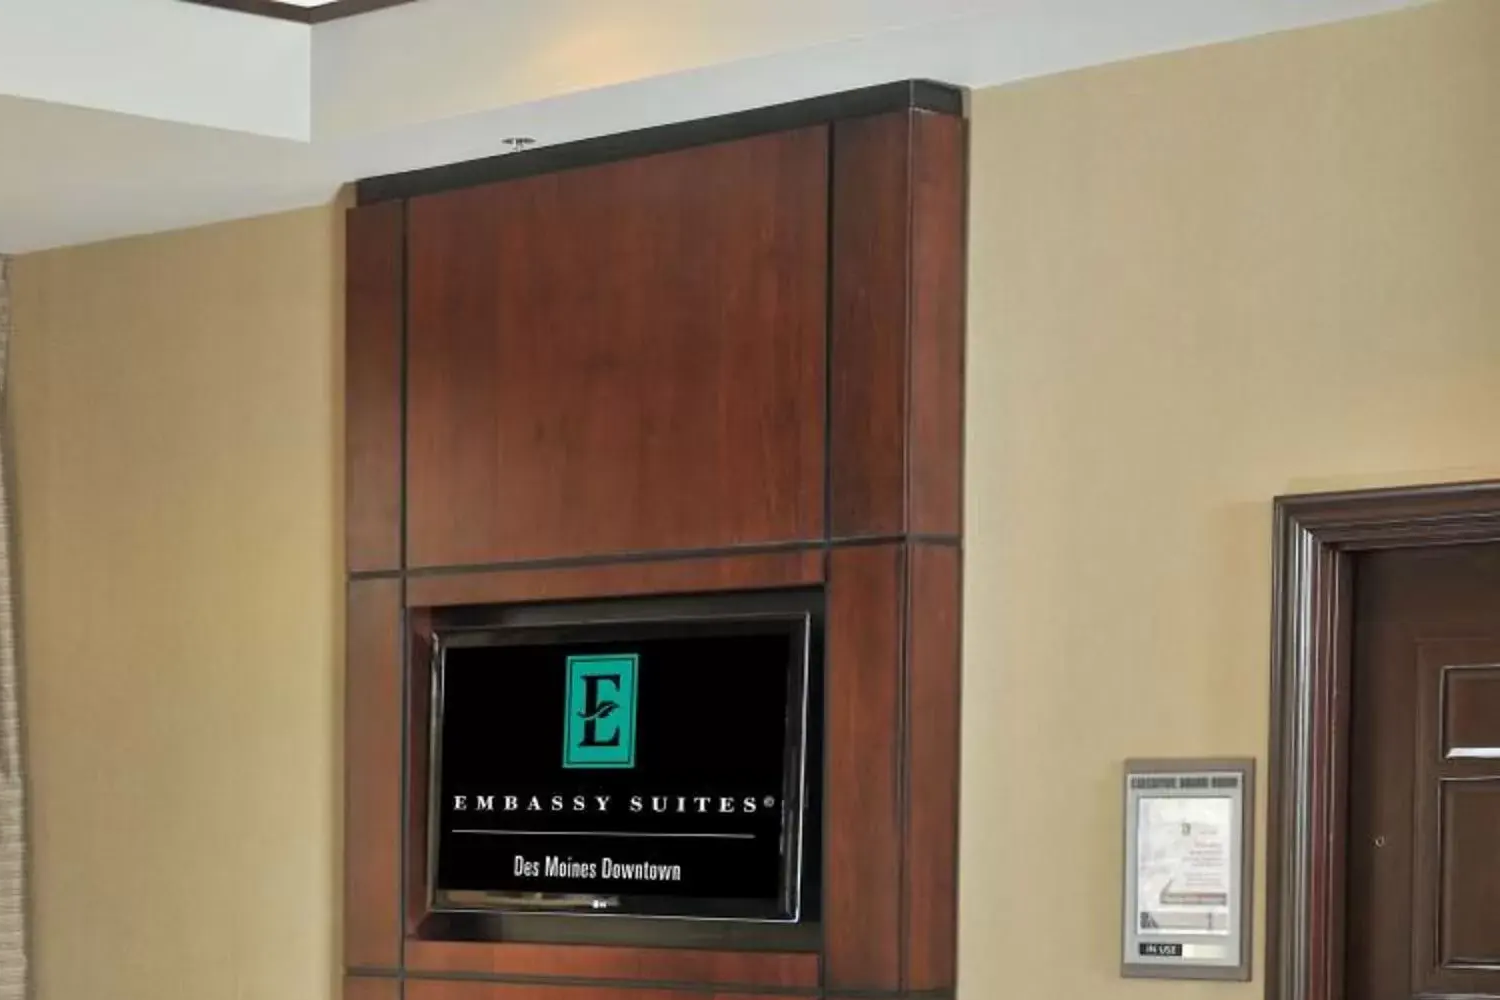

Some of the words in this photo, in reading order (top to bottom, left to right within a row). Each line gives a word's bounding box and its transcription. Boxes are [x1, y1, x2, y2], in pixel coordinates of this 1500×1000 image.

[453, 795, 611, 812] EMBASSY
[513, 854, 540, 877] Des
[544, 855, 597, 879] Moines
[601, 857, 681, 881] Downtown
